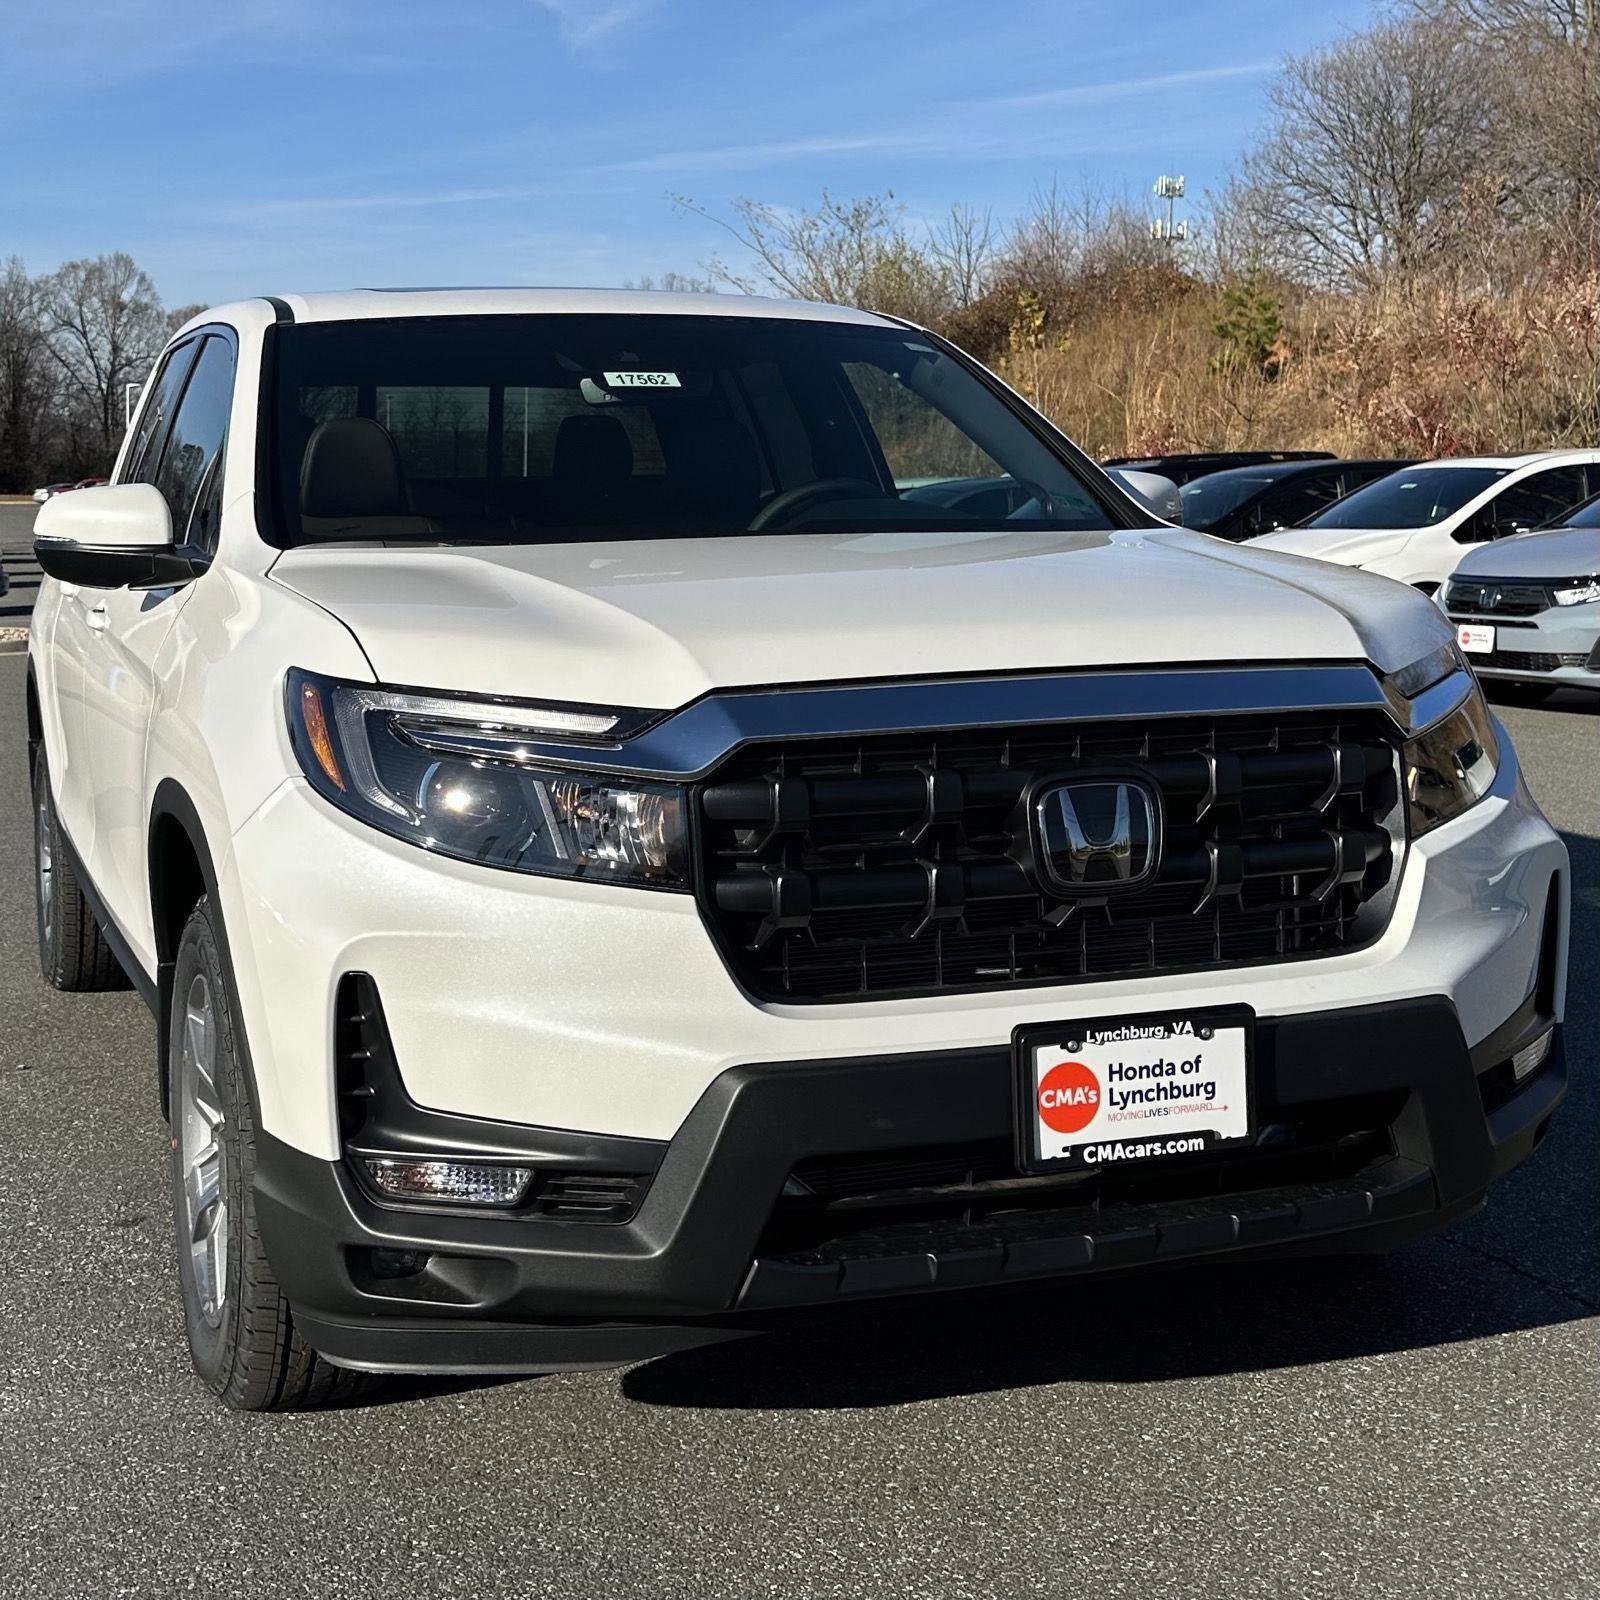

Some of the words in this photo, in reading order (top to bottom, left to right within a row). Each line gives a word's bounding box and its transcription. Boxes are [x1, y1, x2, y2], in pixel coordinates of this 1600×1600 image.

[615, 374, 670, 385] 17562
[1086, 1024, 1170, 1044] Lynchburg,
[1172, 1021, 1194, 1035] VA
[1108, 1058, 1176, 1082] Honda
[1180, 1055, 1202, 1074] of
[1040, 1085, 1098, 1108] CMA's
[1108, 1080, 1216, 1110] Lynchburg
[1084, 1138, 1204, 1162] CMAcars.com
